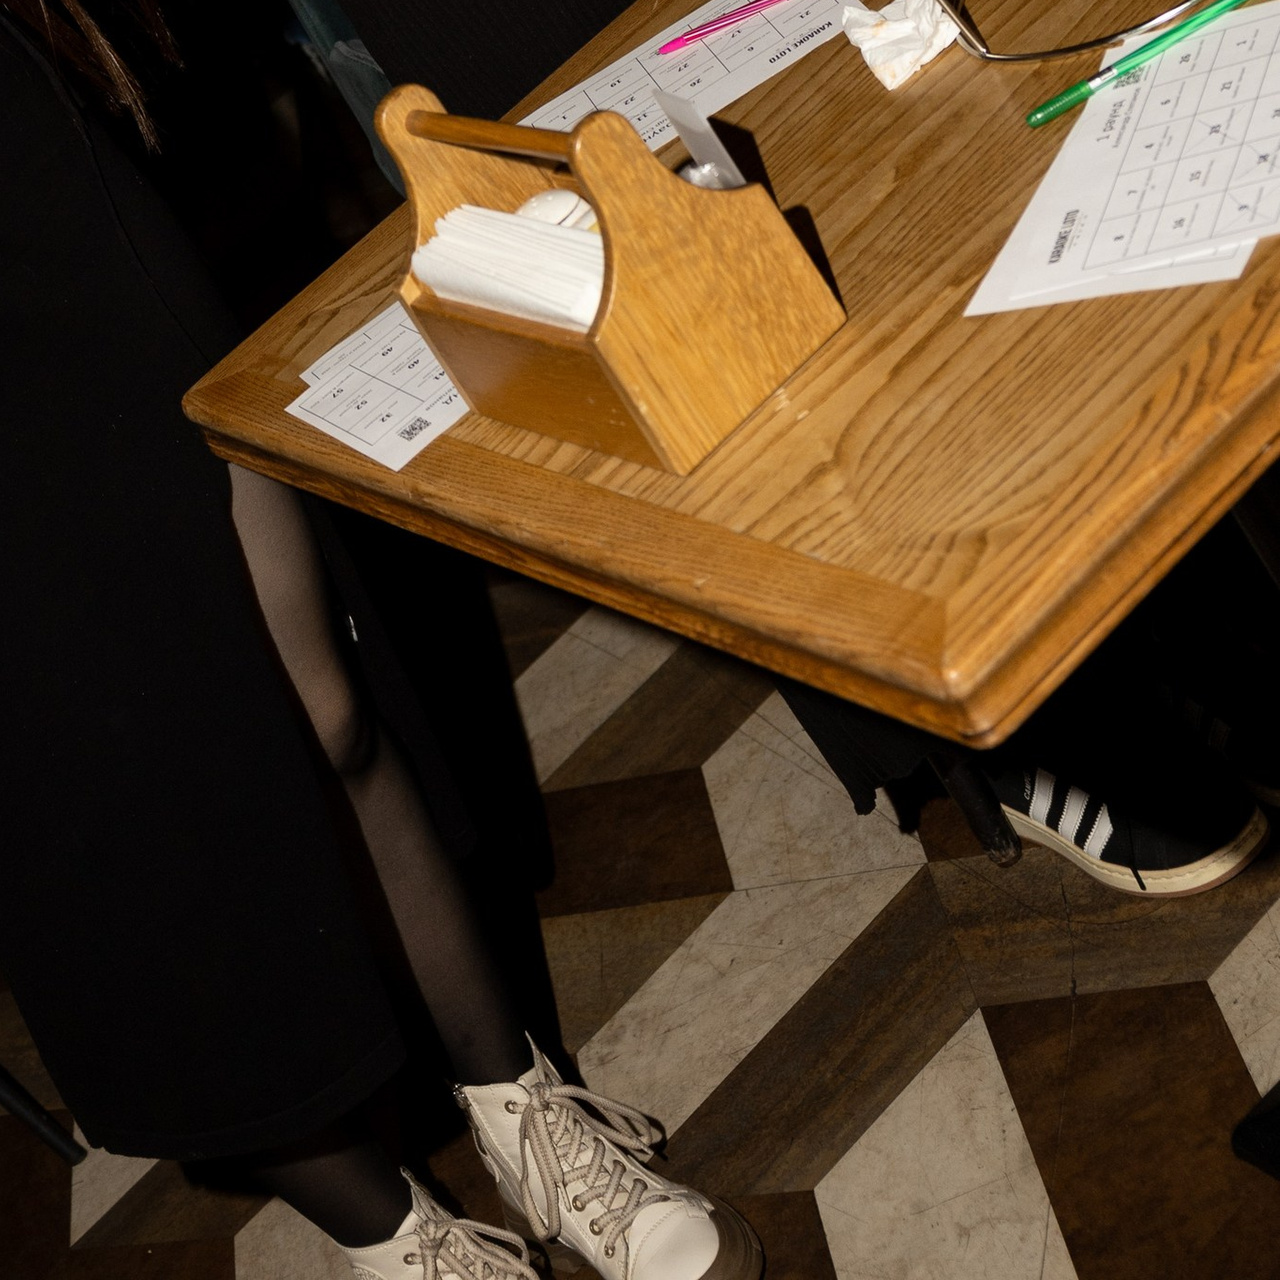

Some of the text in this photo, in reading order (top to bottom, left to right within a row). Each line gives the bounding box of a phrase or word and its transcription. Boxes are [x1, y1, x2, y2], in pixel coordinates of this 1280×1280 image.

[799, 10, 811, 19] 21
[793, 21, 833, 49] KARAOKE
[768, 47, 792, 64] LOTO
[677, 62, 690, 73] 27
[609, 79, 622, 88] 19
[689, 78, 702, 88] 26
[623, 96, 636, 106] 22
[381, 346, 393, 357] 49
[407, 359, 420, 369] 40
[332, 388, 344, 399] 57
